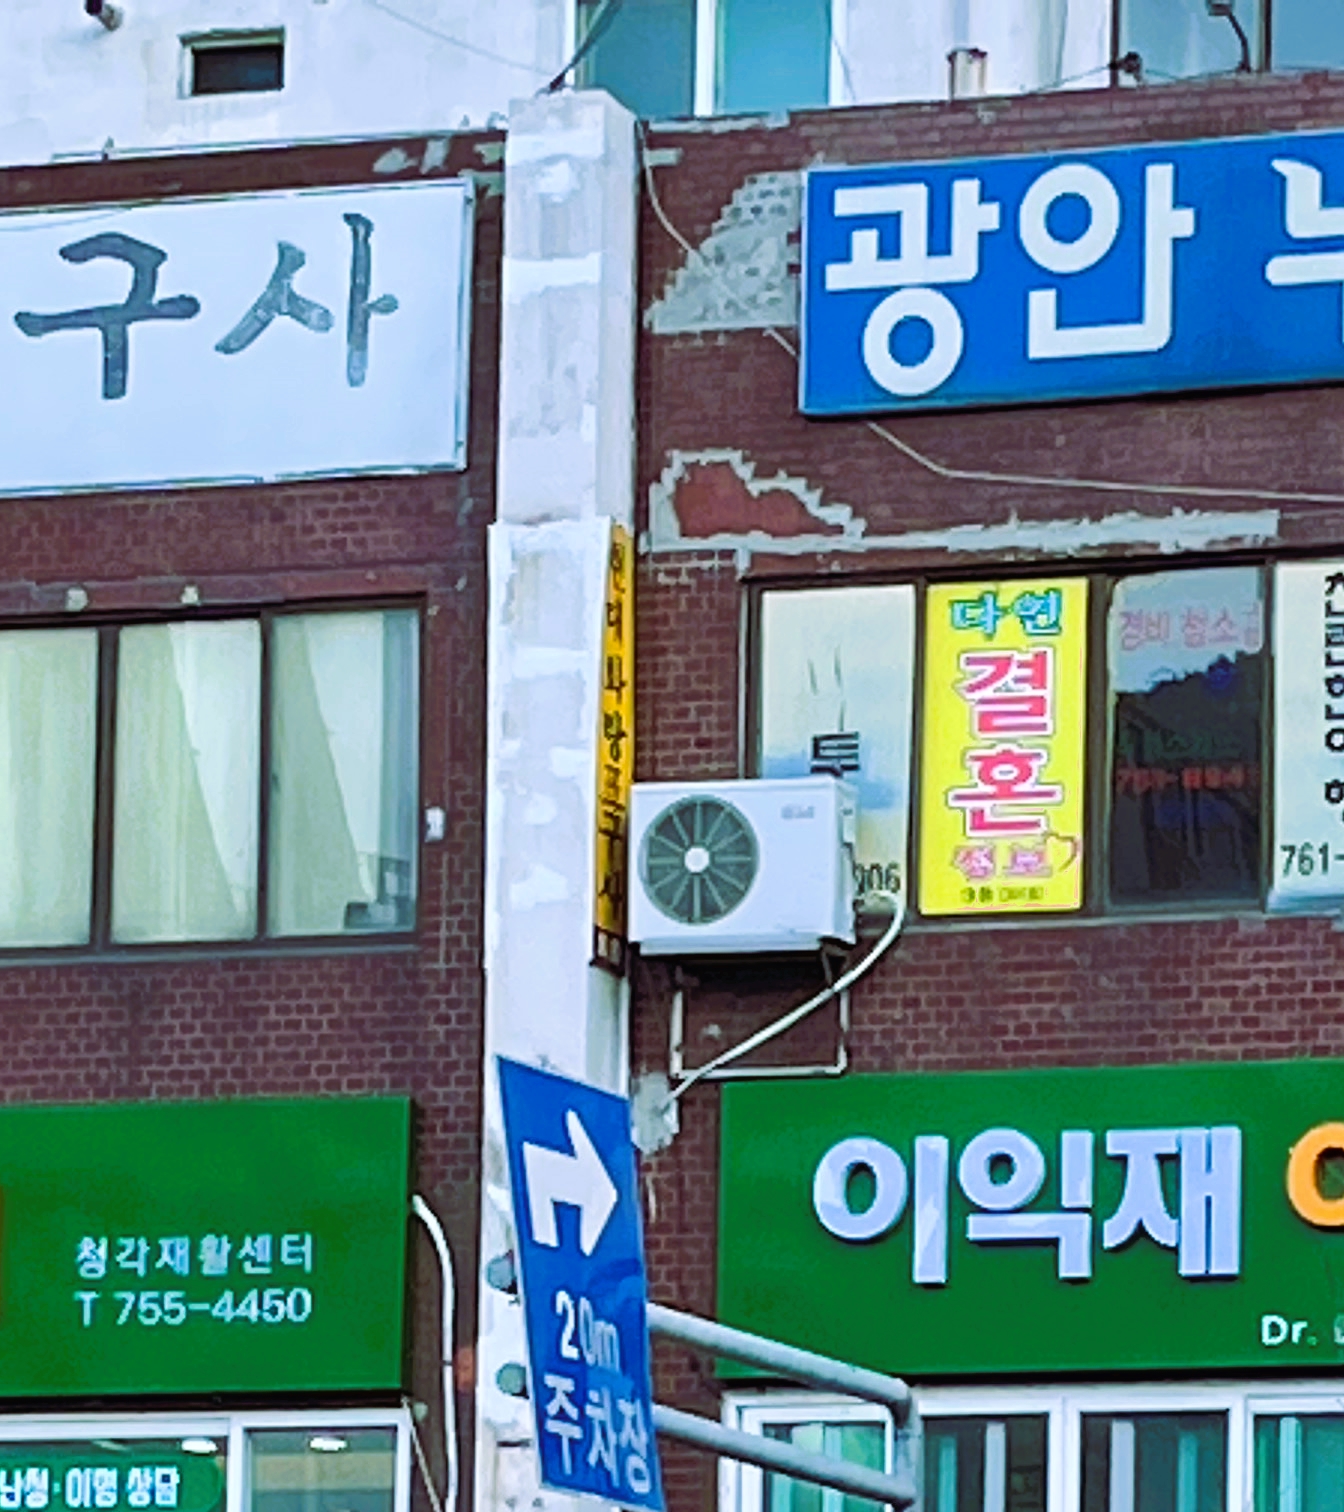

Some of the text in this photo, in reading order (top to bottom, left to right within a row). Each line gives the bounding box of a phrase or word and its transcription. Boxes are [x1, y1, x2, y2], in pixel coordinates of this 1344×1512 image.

[824, 162, 1194, 397] 광안
[945, 643, 1064, 838] 결혼
[813, 1126, 1243, 1288] 이익재
[73, 1231, 315, 1281] 청각재활센터
[75, 1284, 313, 1328] T 755-4450
[555, 1289, 622, 1371] 20m
[1262, 1314, 1318, 1346] Dr.
[543, 1373, 653, 1495] 주차장
[127, 1465, 180, 1508] 상담
